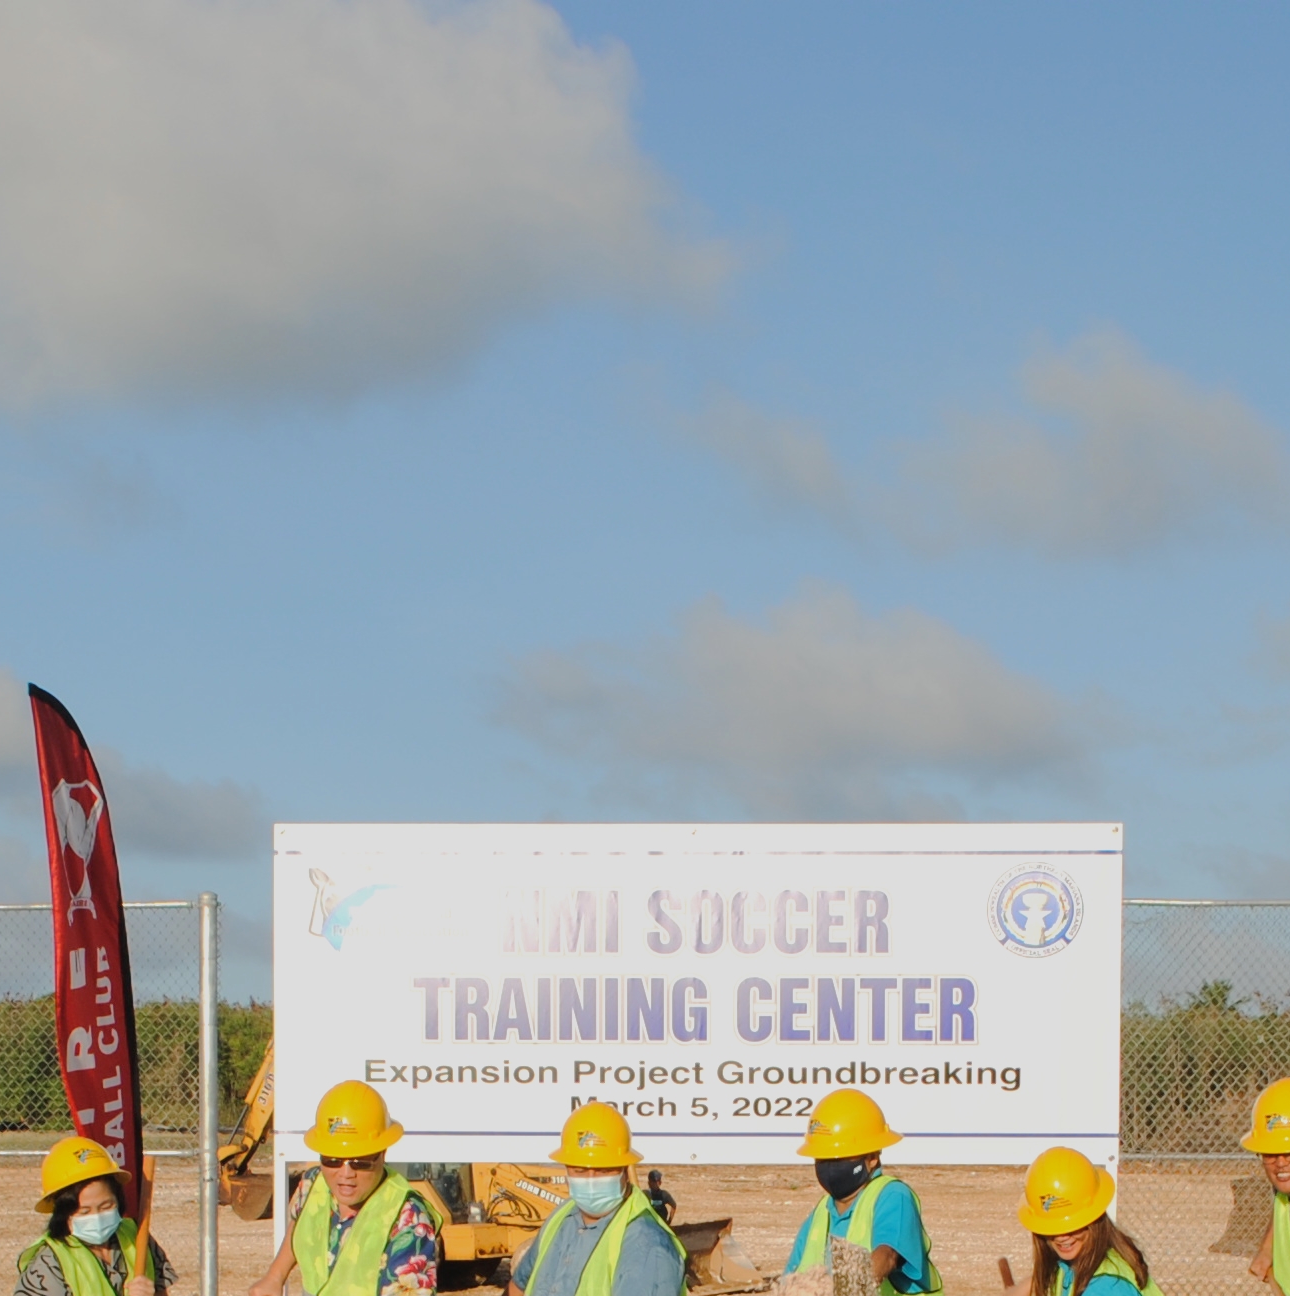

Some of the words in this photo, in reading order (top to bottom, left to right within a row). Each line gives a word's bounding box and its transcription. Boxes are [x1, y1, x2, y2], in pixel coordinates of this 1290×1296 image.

[503, 889, 620, 954] NMI
[646, 889, 891, 955] SOCCER
[412, 976, 709, 1042] TRAINING
[736, 976, 976, 1042] CENTER
[364, 1059, 559, 1089] Expansion
[573, 1060, 704, 1090] Project
[716, 1060, 1022, 1091] Groundbreaking
[570, 1096, 677, 1117] Mrch
[690, 1097, 718, 1120] 5,
[732, 1097, 813, 1117] 2022
